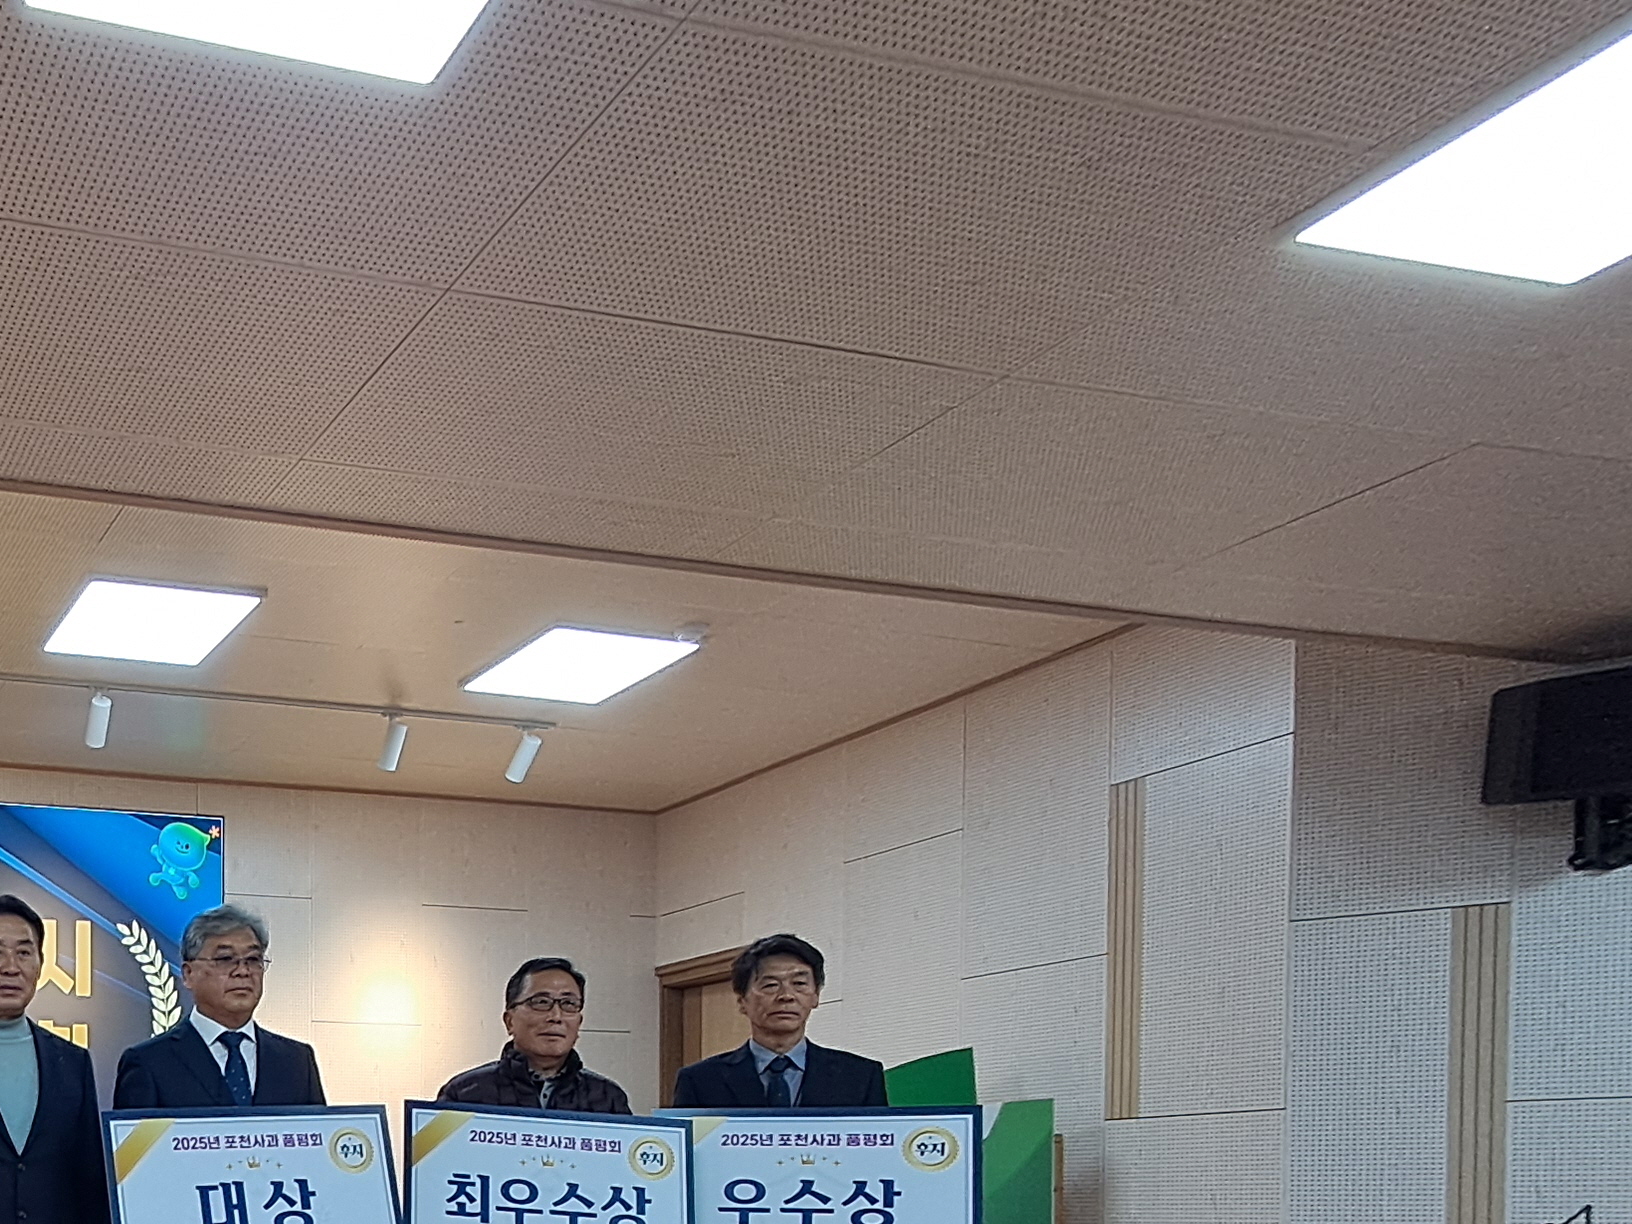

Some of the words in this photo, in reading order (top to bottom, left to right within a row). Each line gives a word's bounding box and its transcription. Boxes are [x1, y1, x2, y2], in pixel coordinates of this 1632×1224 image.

[171, 1132, 221, 1151] 2025년
[224, 1134, 279, 1149] 포천사과
[282, 1133, 324, 1148] 품평회
[469, 1129, 517, 1147] 2025년
[520, 1133, 576, 1150] 포천사과
[580, 1137, 622, 1154] 품평회
[721, 1133, 774, 1147] 2025년
[778, 1133, 842, 1147] 포천사과
[845, 1133, 895, 1147] 품평회
